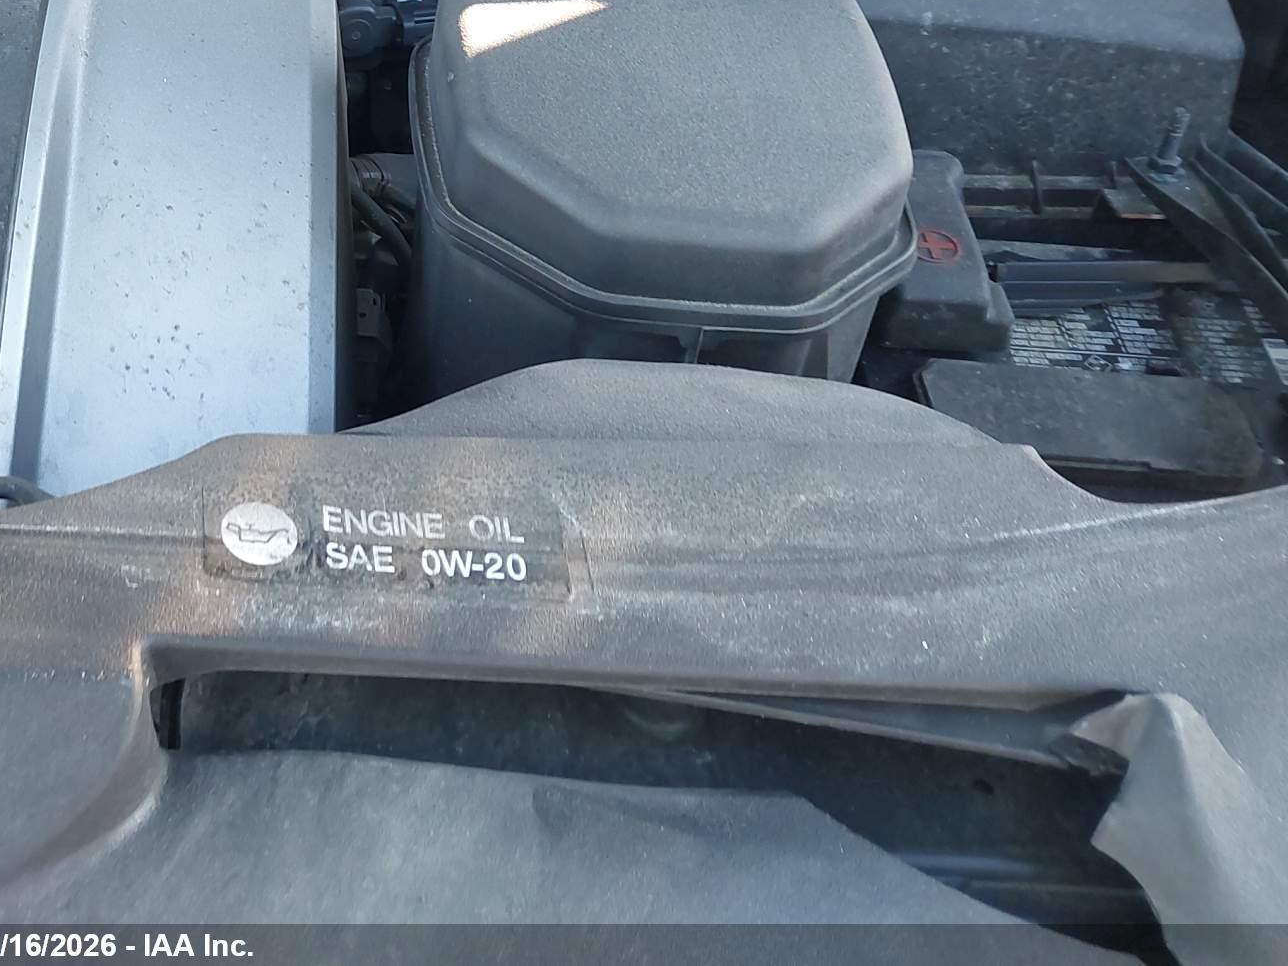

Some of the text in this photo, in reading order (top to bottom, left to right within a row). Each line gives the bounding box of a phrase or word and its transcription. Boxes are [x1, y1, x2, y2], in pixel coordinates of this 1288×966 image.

[322, 505, 525, 543] ENGINE OIL
[326, 543, 528, 582] SAE 0W-20
